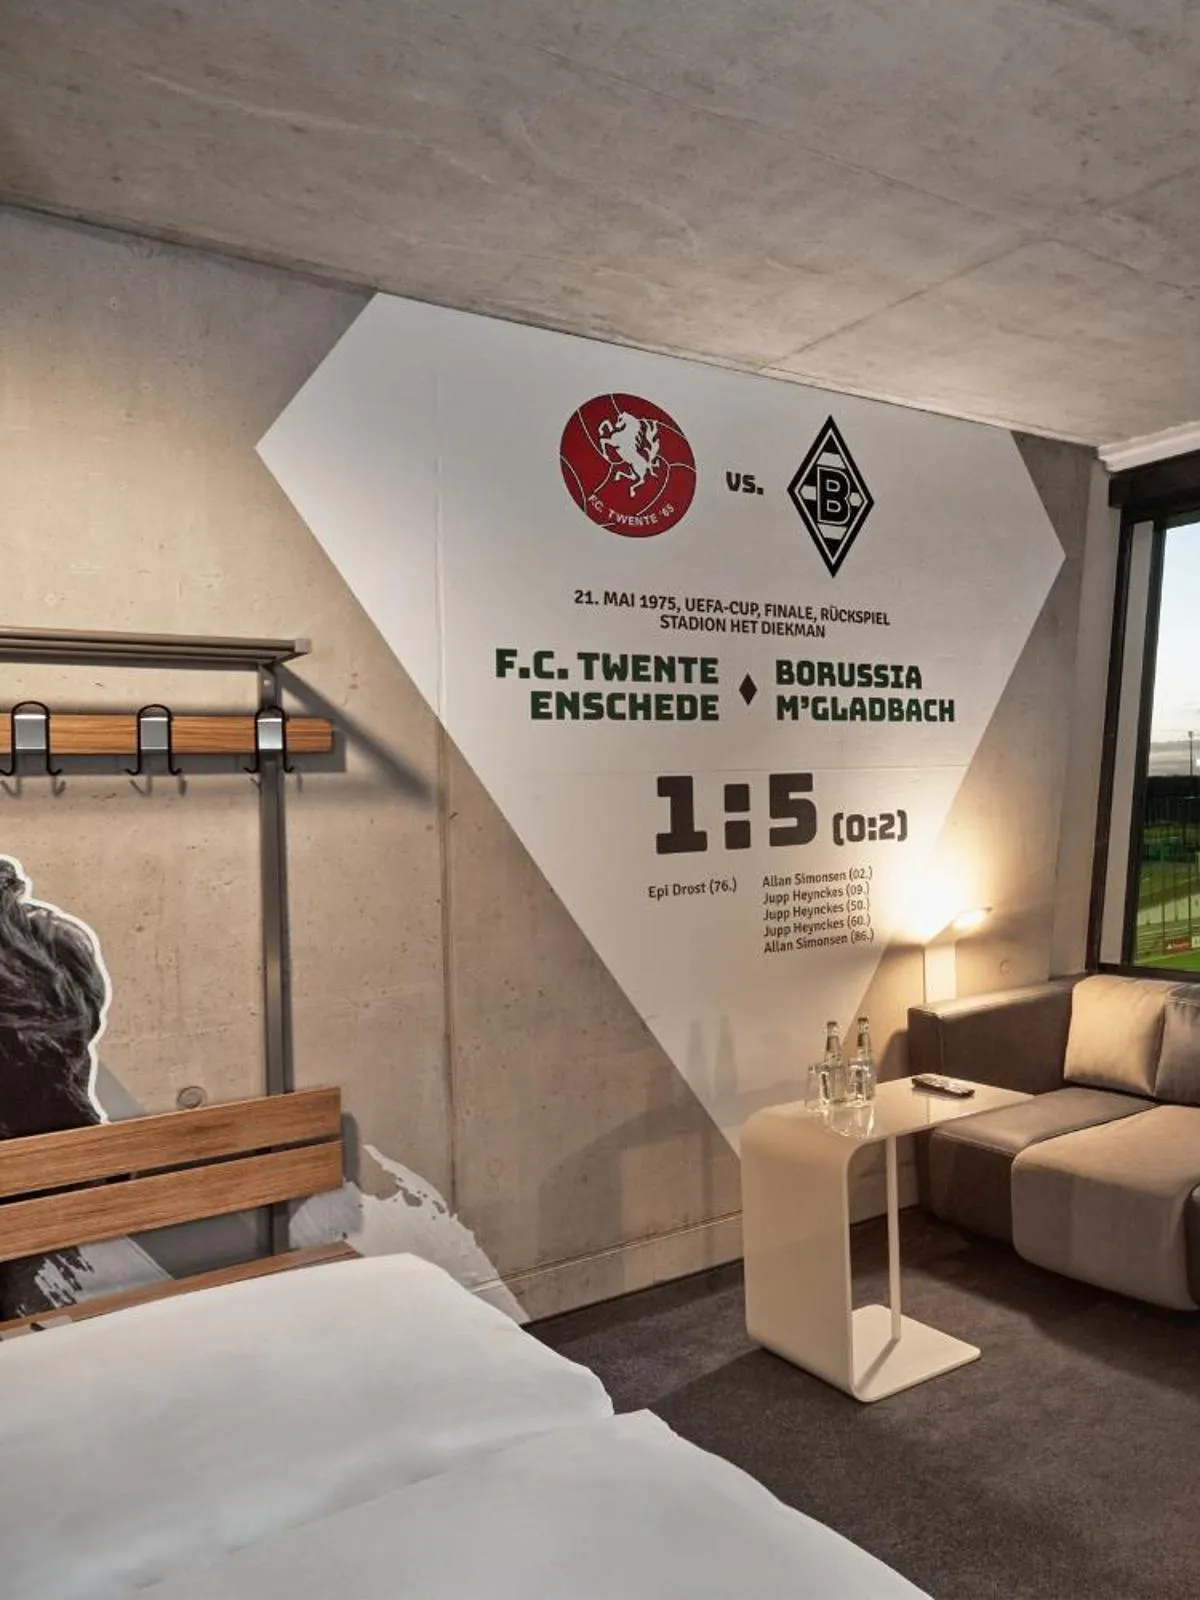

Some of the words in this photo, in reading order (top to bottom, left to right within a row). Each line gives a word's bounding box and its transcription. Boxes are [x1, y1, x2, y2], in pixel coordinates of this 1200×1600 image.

[816, 466, 851, 525] B
[588, 494, 604, 513] F.C.
[608, 508, 658, 526] TWENTE
[574, 589, 599, 605] 21.
[603, 591, 635, 607] MAI
[640, 595, 681, 613] 1975,
[685, 598, 761, 618] UEFA-CUP,
[764, 603, 817, 622] FINALE,
[820, 606, 891, 626] RÜCKSPIEL
[660, 614, 726, 633] STADION
[730, 620, 757, 635] HET
[761, 621, 826, 638] DIEKMAN
[495, 649, 568, 680] F.C.
[577, 651, 719, 684] TWENTE
[775, 660, 922, 690] BORUSSIA
[530, 691, 720, 722] ENSCHEDE
[832, 809, 909, 846] (0:2)
[648, 885, 669, 900] Epi
[672, 881, 707, 897] Drost
[709, 877, 738, 895] (76.)
[762, 875, 792, 888] Allan
[795, 871, 847, 885] Simonsen
[763, 892, 790, 905] Jupp
[793, 887, 844, 903] Heynckes
[763, 909, 790, 922] Jupp
[793, 902, 844, 918] Heynckes
[847, 897, 871, 913] (50.)
[763, 925, 791, 938] Jupp
[793, 918, 845, 935] Heynckes
[847, 913, 871, 930] (60.)
[764, 940, 793, 953] Allan
[796, 935, 848, 950] Simonsen
